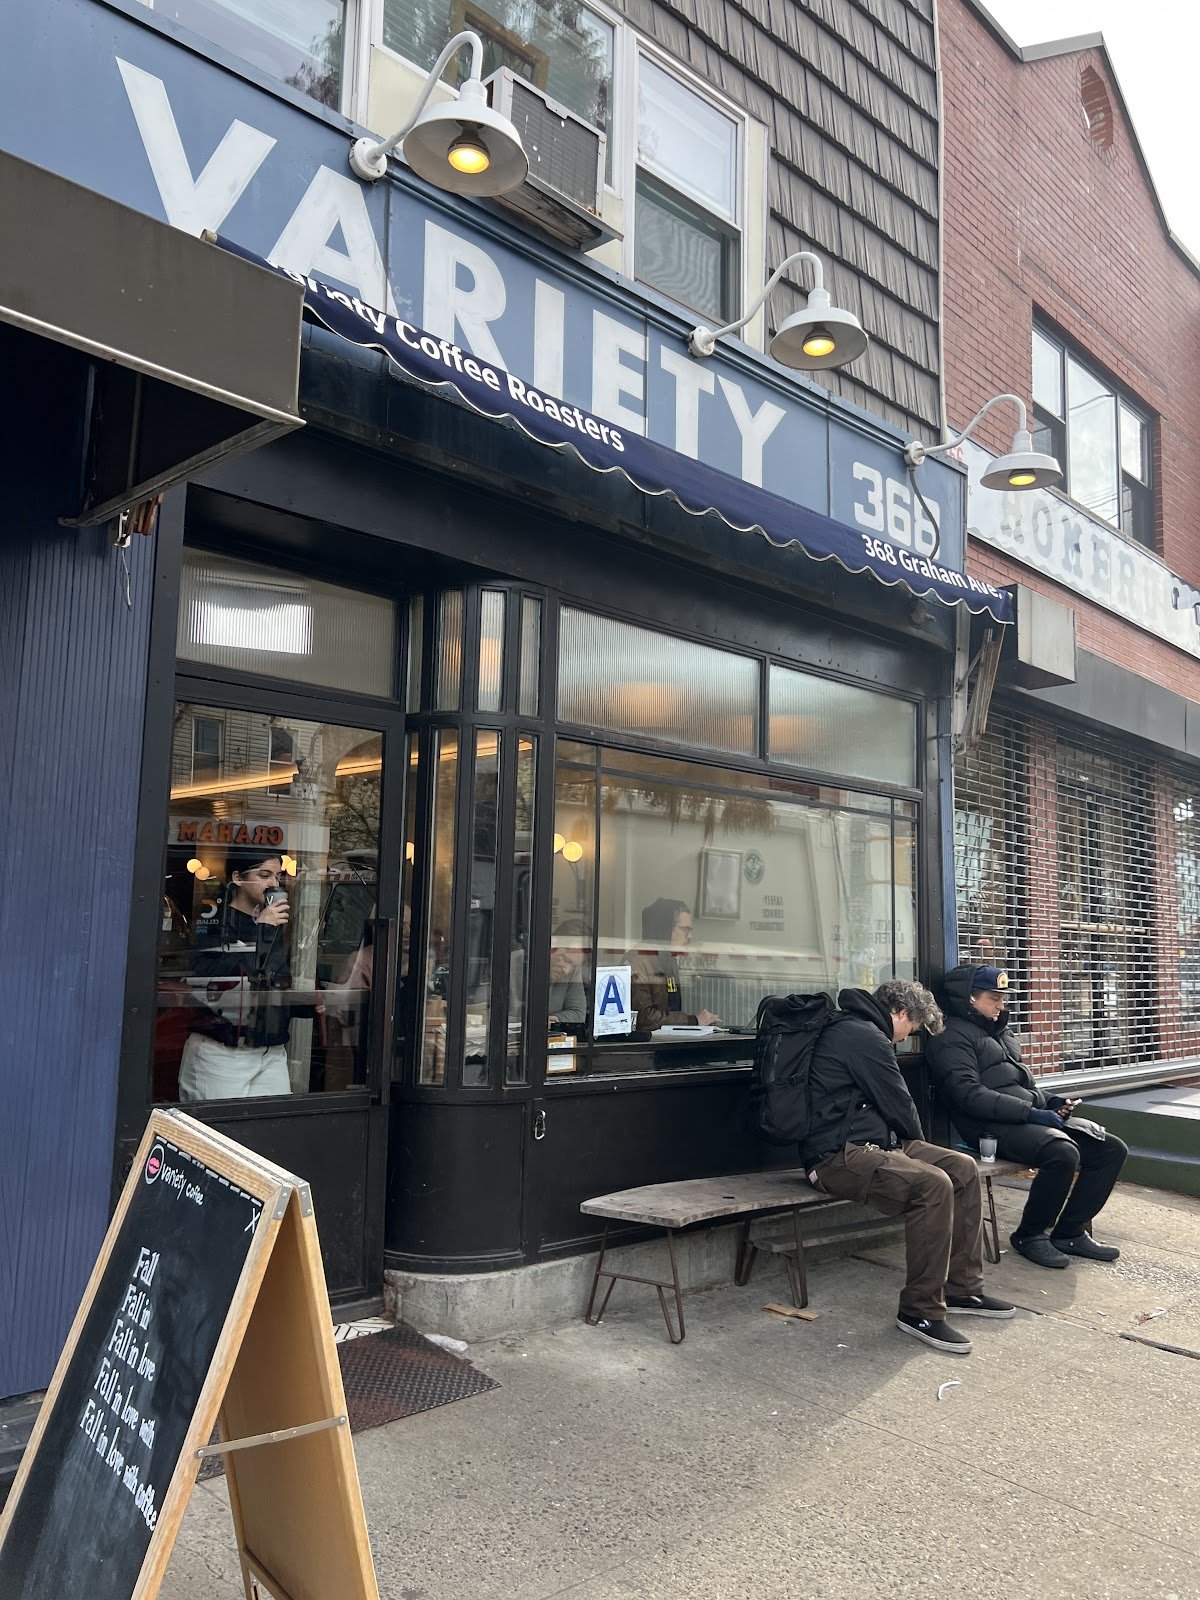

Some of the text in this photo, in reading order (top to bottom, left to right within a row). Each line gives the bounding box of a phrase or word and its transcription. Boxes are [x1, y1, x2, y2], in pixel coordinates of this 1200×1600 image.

[115, 56, 787, 488] VARIETY
[264, 258, 625, 452] ariety Coffee Roasters
[852, 461, 940, 560] 368
[861, 534, 897, 566] 368
[898, 549, 968, 589] Graham
[599, 975, 625, 1015] A
[132, 1246, 160, 1287] Fall
[121, 1283, 151, 1331] Fall in
[107, 1318, 156, 1382] Fall in love
[93, 1356, 157, 1450] Fall in love with
[79, 1398, 158, 1532] Fall in love with coffee
